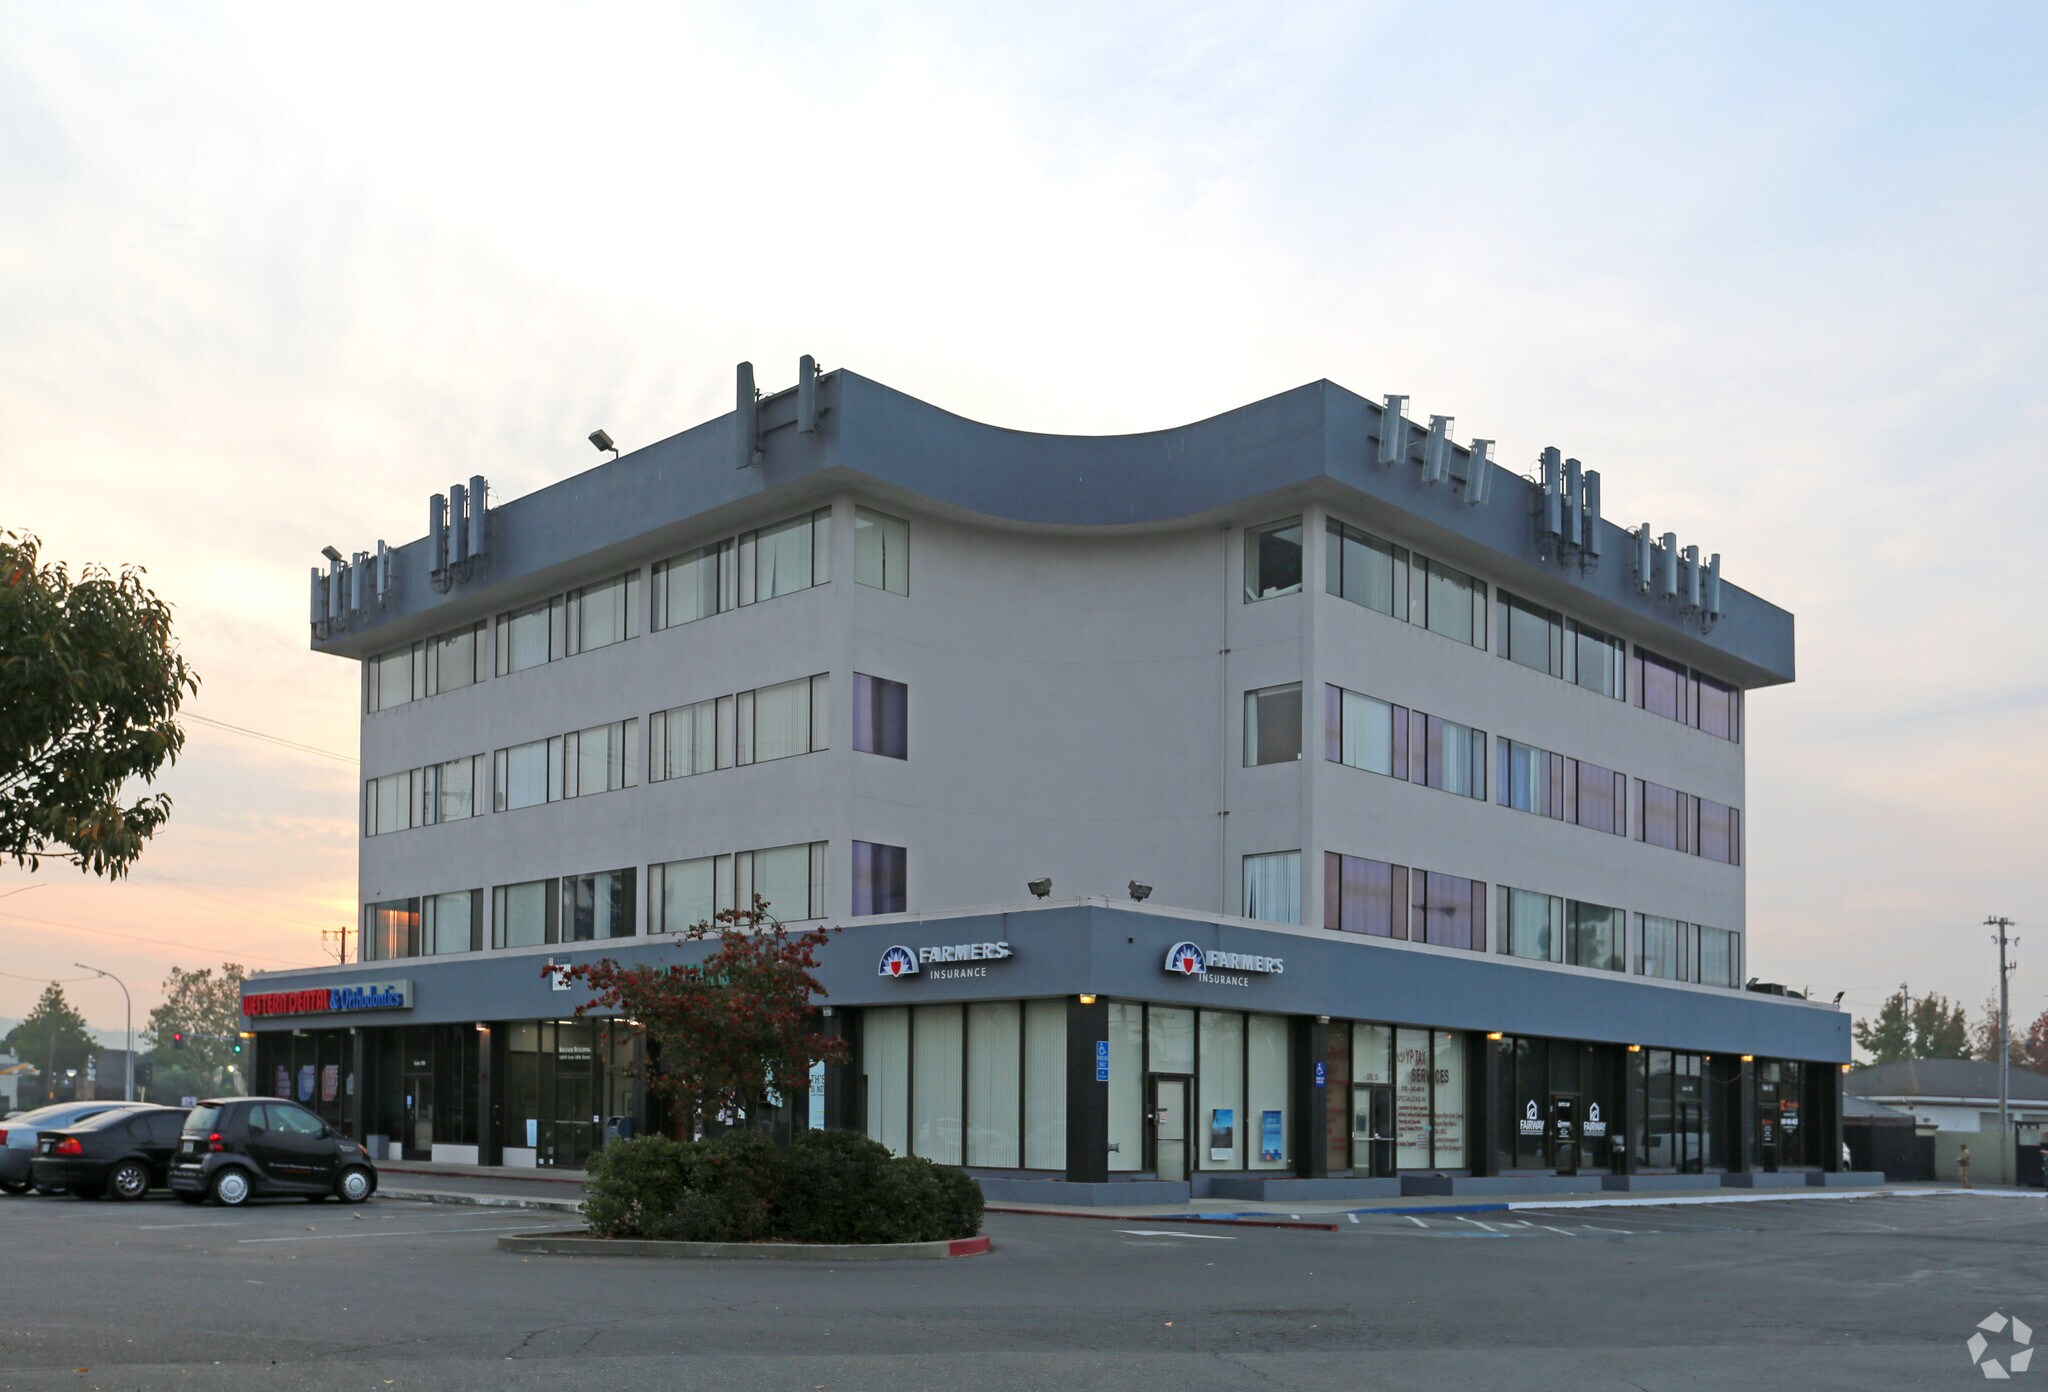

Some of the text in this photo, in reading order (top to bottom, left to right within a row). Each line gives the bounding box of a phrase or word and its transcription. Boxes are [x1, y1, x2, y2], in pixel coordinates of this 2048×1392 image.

[920, 942, 1009, 963] FARMERS
[1206, 950, 1284, 974] FARMERS
[930, 967, 987, 979] INSURANCE
[1199, 973, 1249, 987] INSURANCE
[243, 985, 403, 1017] WESTERN DENTAL & Orthodontics
[1415, 1050, 1426, 1066] TAX
[1411, 1068, 1449, 1083] SERVCES
[1520, 1120, 1545, 1130] FAIRWAY
[1583, 1121, 1606, 1131] FAIRWAY
